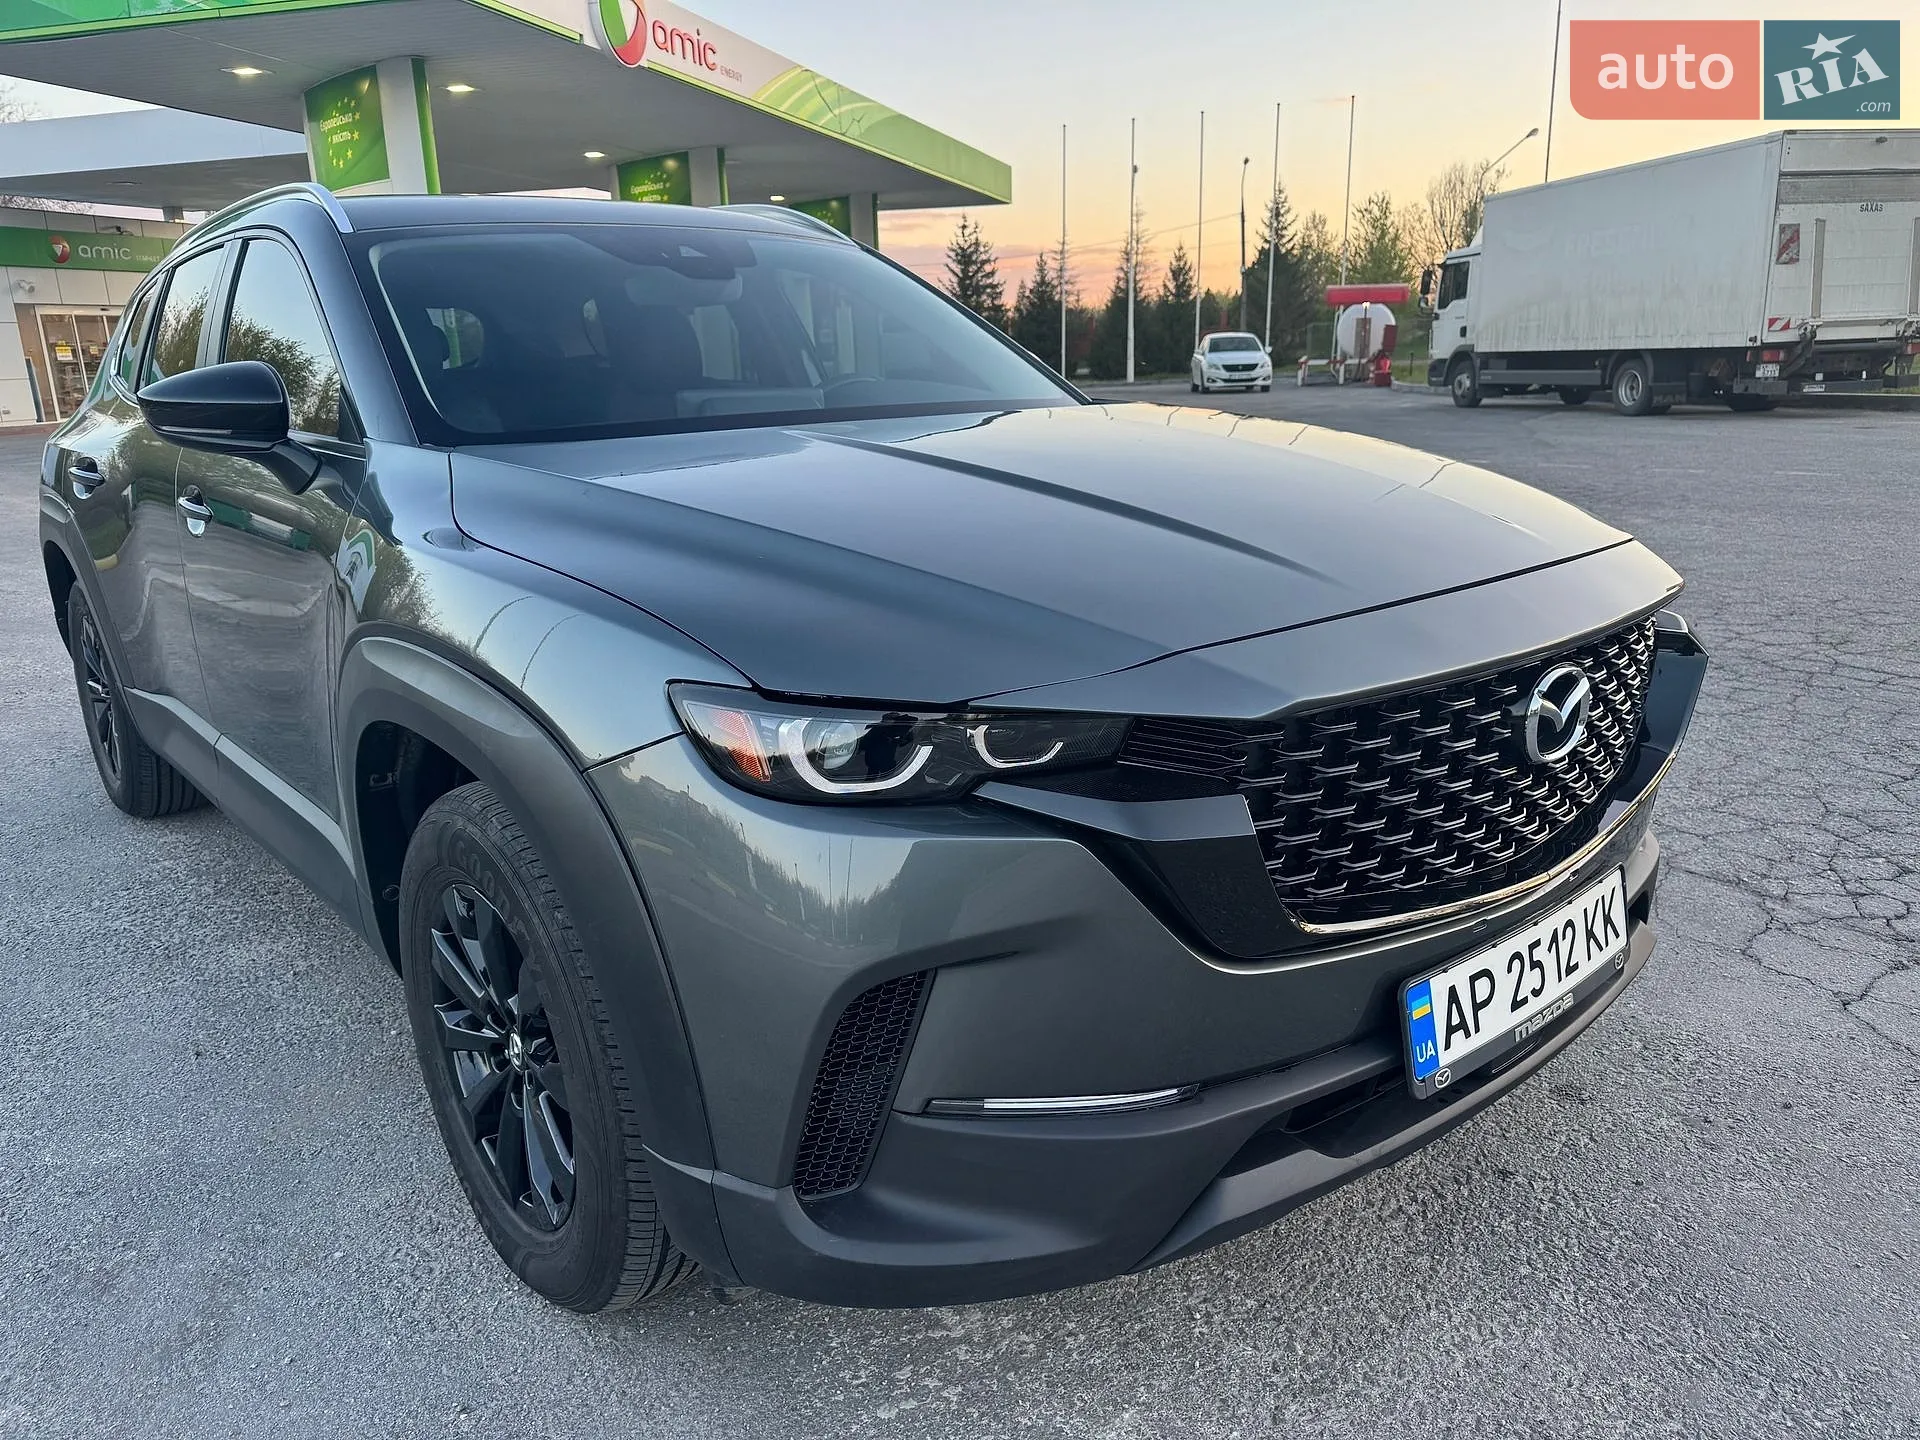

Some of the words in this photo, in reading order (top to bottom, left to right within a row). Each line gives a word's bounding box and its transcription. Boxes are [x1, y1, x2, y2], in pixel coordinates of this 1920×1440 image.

[652, 19, 718, 72] amic
[78, 243, 131, 261] amic
[1444, 968, 1496, 1052] AP
[1506, 918, 1579, 1013] 2512
[1583, 886, 1621, 962] KK
[1514, 992, 1575, 1043] mazda
[1416, 1042, 1436, 1063] UA
